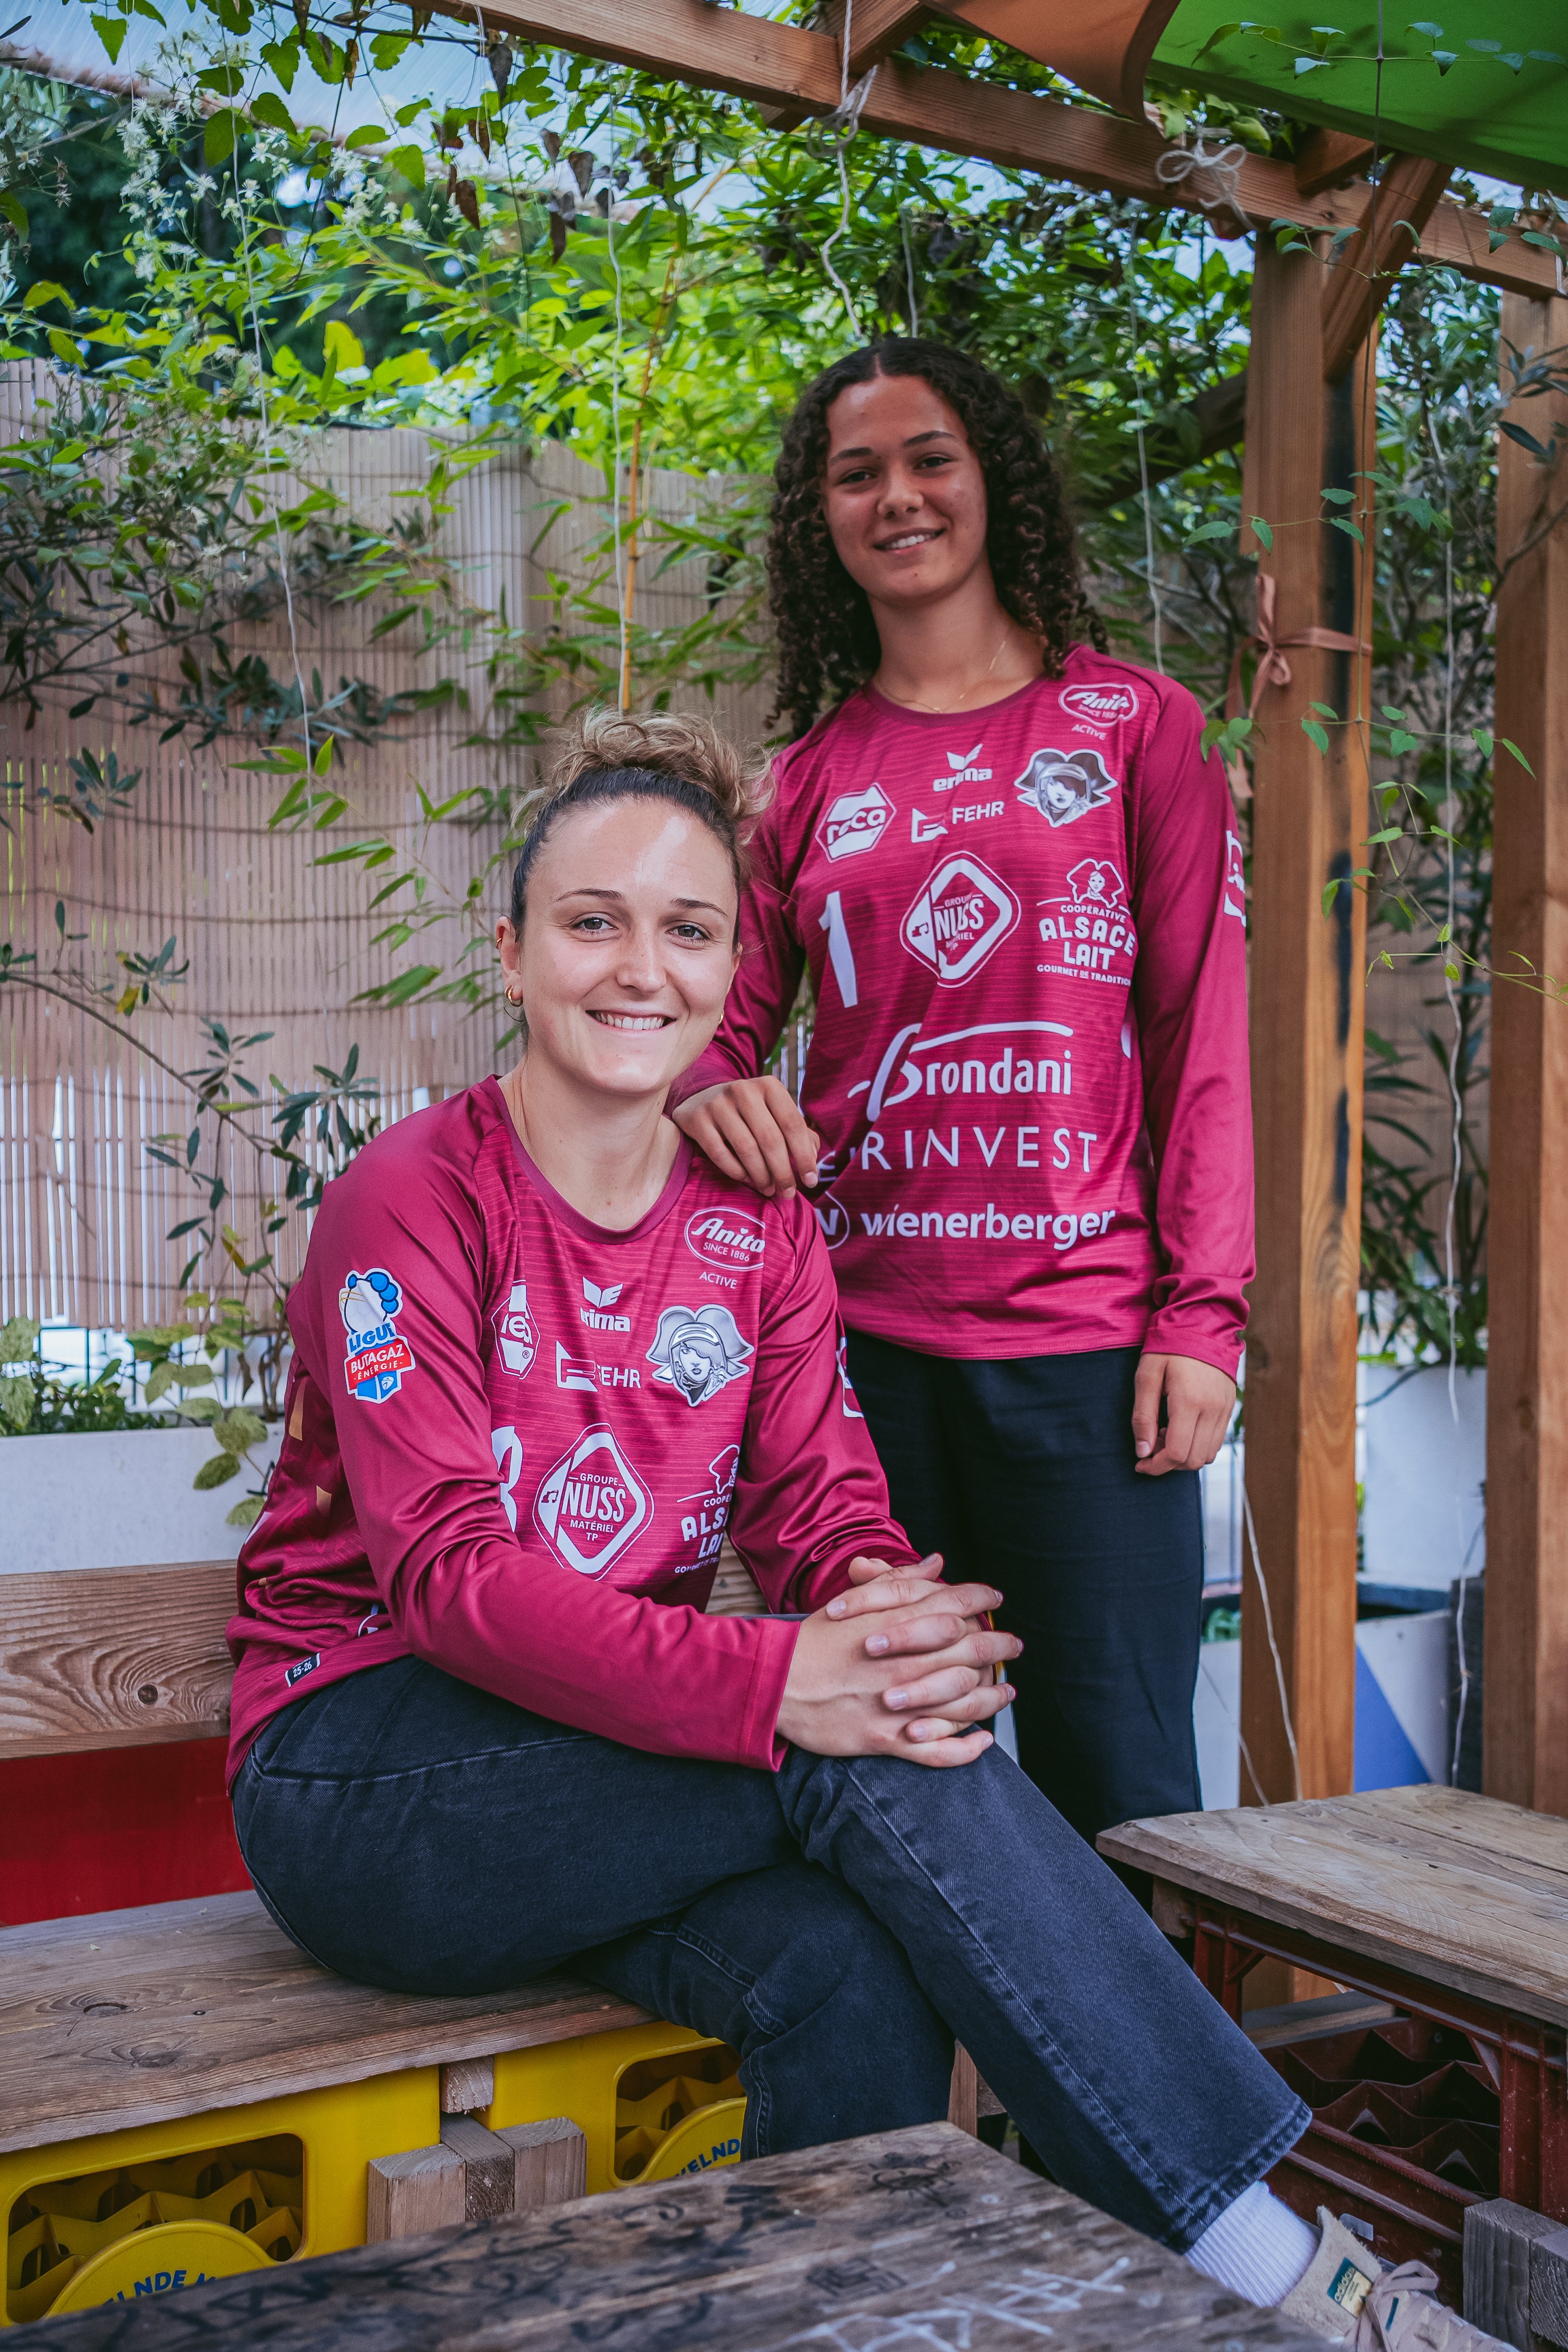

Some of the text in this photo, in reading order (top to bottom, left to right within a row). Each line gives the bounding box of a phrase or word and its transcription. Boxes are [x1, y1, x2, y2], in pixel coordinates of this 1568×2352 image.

[1071, 723, 1106, 740] ACTIVE
[951, 801, 1005, 825] FEHR
[933, 898, 984, 941] NUSS
[818, 891, 859, 1008] 1
[1039, 916, 1136, 957] ALSACE
[1063, 941, 1116, 971] LAIT
[1037, 964, 1078, 977] GOURMET
[847, 1021, 1073, 1121] Brondani
[691, 1218, 765, 1253] Anita
[860, 1203, 1116, 1250] wienerberger
[703, 1242, 750, 1262] SINCE 1886
[699, 1271, 738, 1289] ACTIVE
[350, 1344, 405, 1374] BUTAGAZ
[579, 1473, 618, 1486] GROUPE
[561, 1481, 626, 1523] NUSS
[569, 1519, 615, 1533] MATÉRIEL
[586, 1532, 599, 1541] TP
[293, 1661, 312, 1678] 25-26
